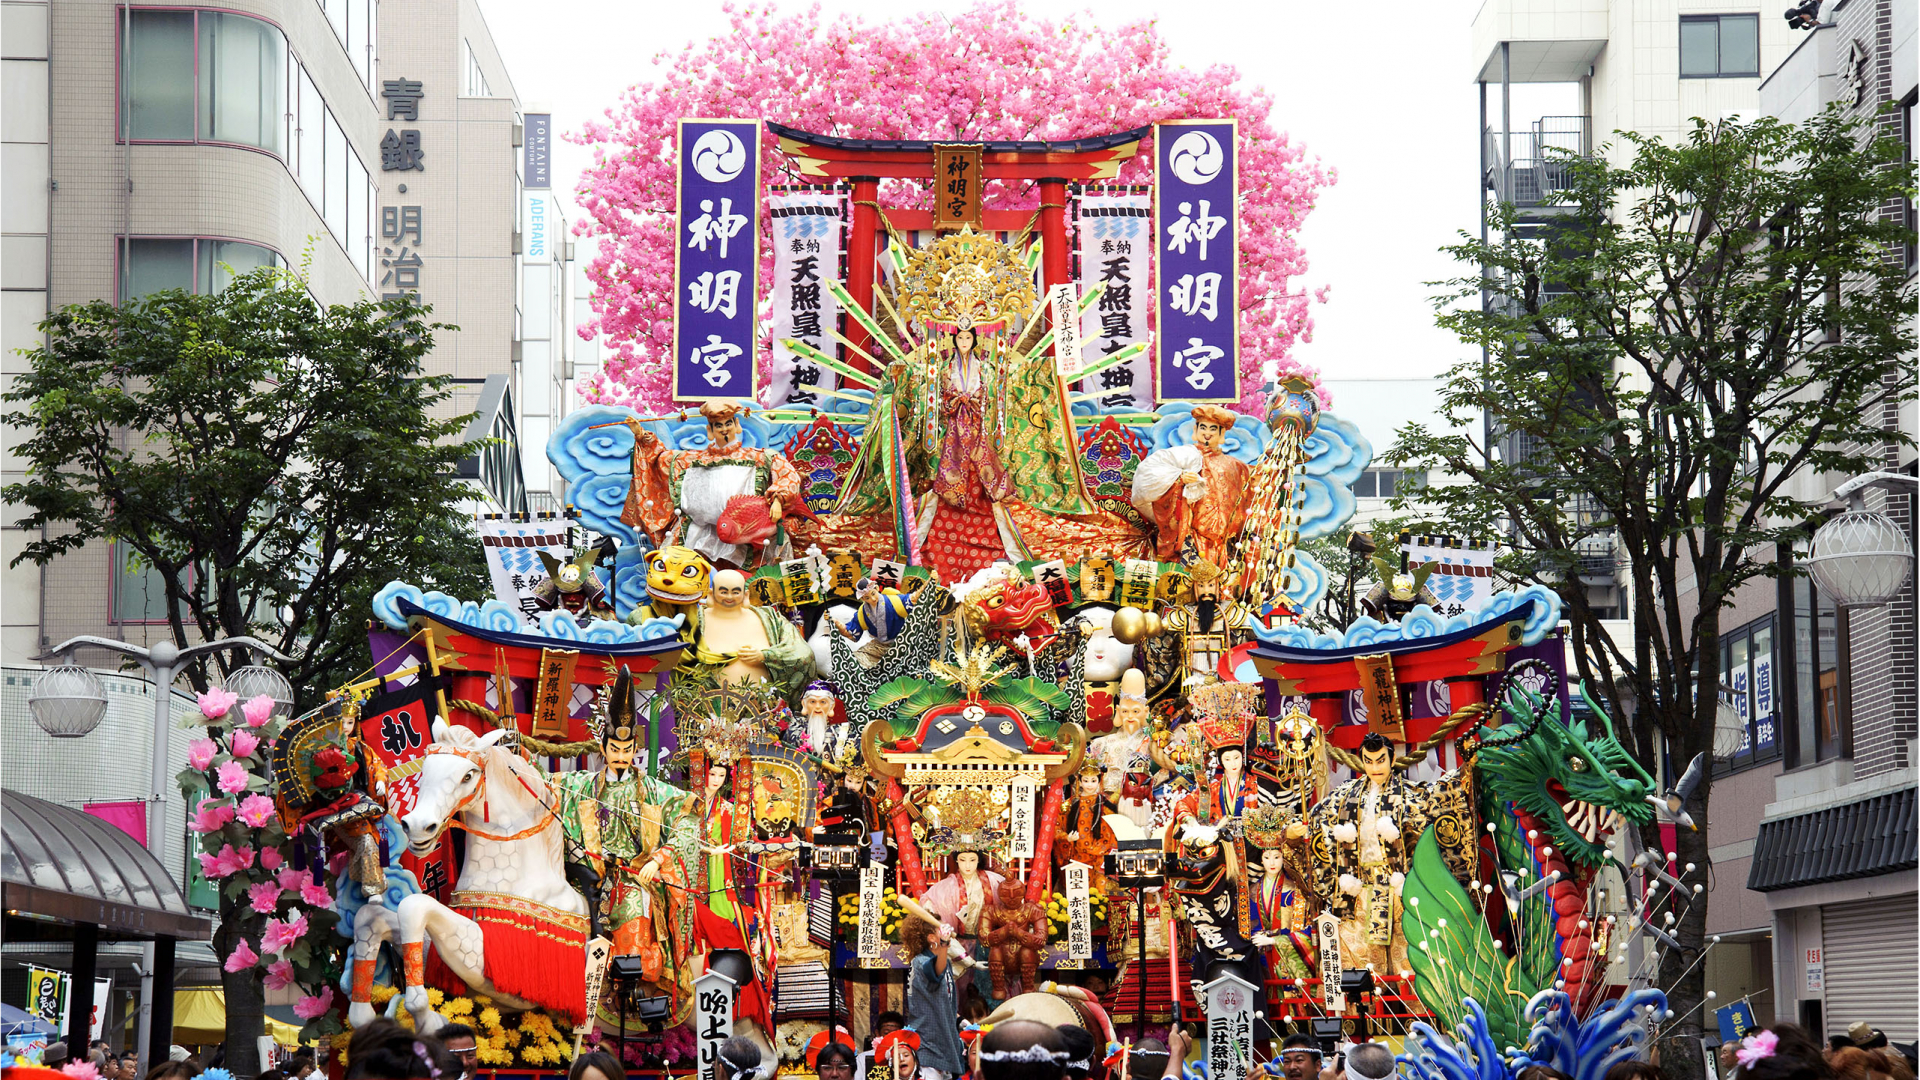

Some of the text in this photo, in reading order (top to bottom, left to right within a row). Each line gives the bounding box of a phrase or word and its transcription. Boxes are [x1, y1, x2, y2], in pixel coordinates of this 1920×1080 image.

[536, 120, 546, 183] FONTAINE
[947, 155, 970, 218] 神明宮
[529, 198, 544, 257] ADERANS
[790, 239, 820, 255] 奉納
[1100, 240, 1131, 255] 奉納
[687, 197, 748, 388] 神明宮
[1167, 199, 1227, 391] 神明宮
[542, 661, 563, 722] 新羅神社
[1069, 868, 1083, 890] 国宝
